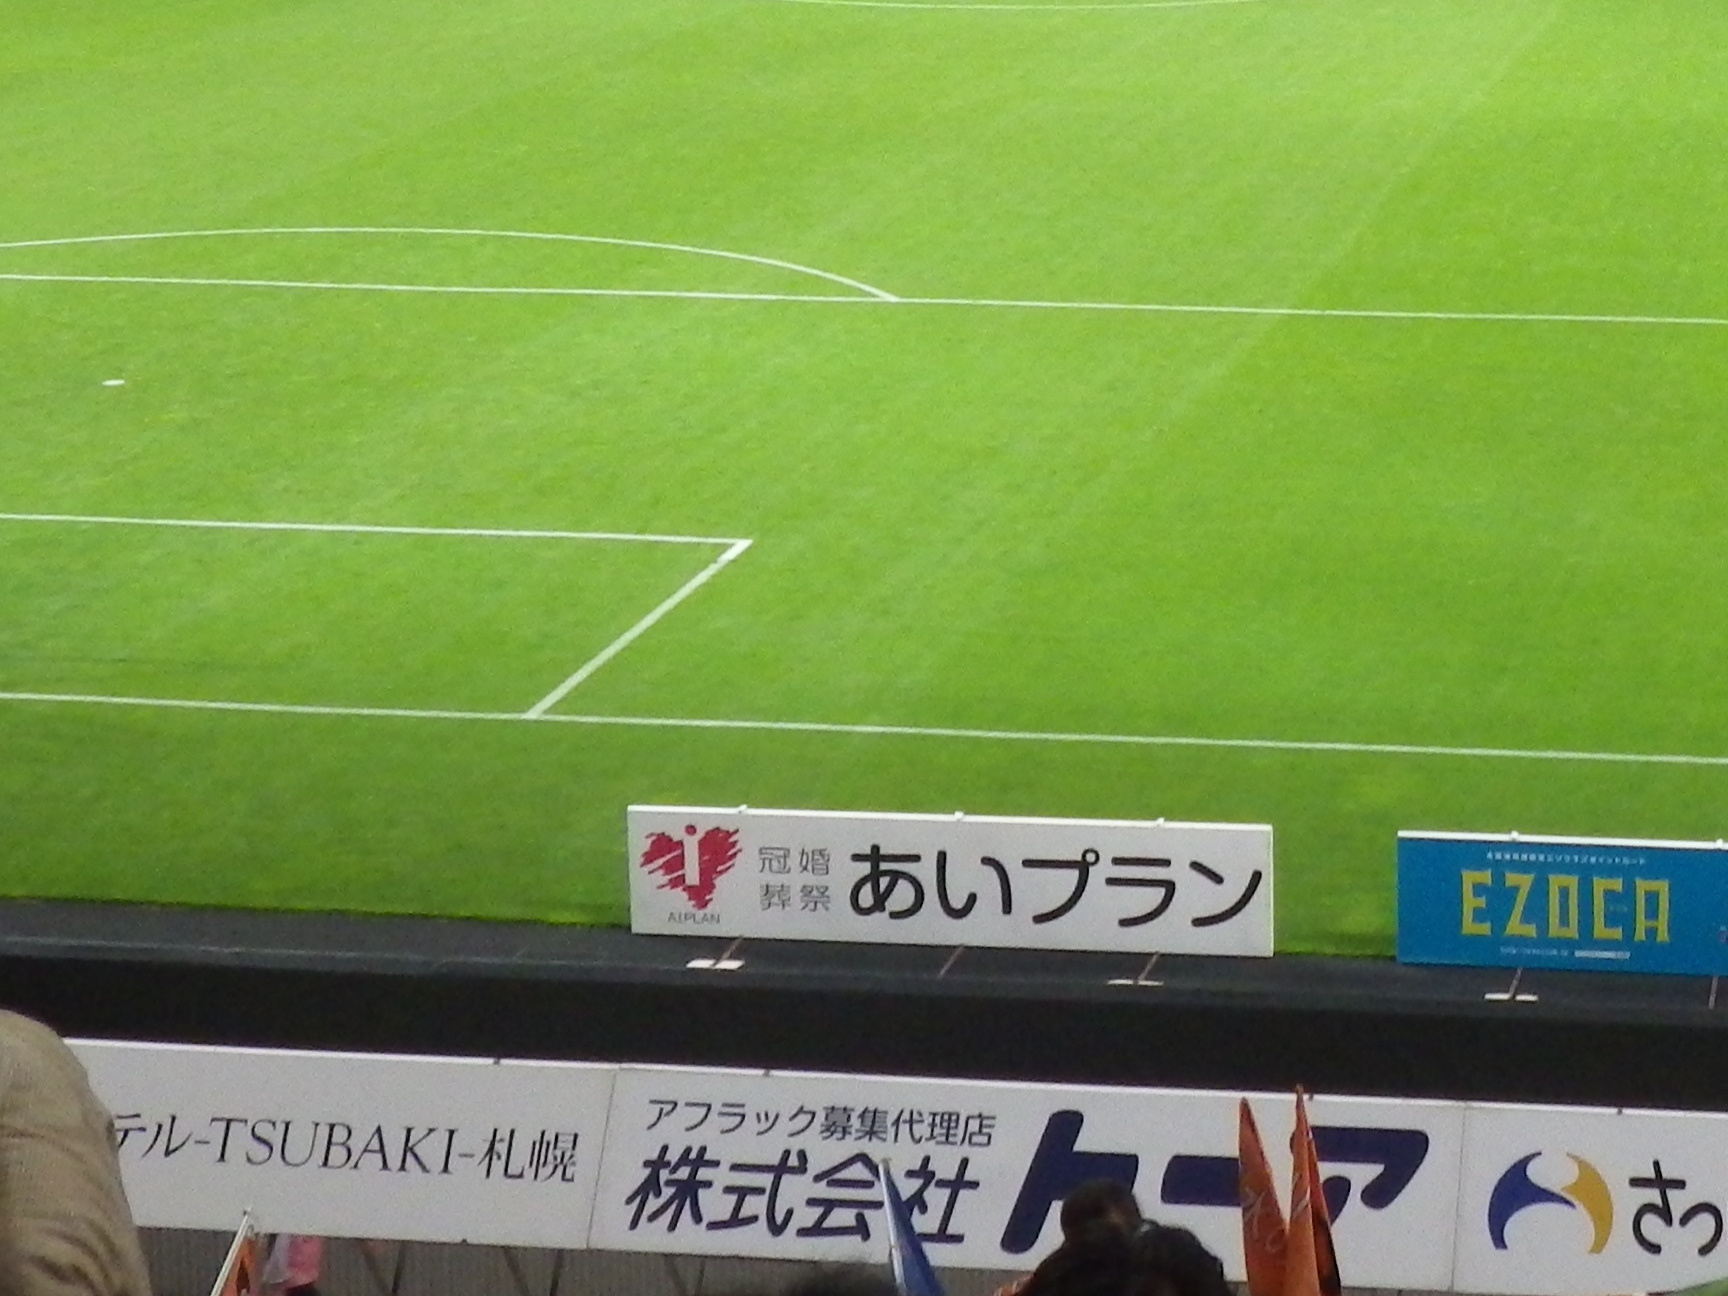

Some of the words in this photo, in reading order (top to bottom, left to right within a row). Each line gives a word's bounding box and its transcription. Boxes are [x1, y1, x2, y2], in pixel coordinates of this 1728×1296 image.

[757, 845, 833, 878] 冠婚
[847, 841, 1264, 930] あいプラン
[666, 911, 722, 927] AIPLAN
[757, 881, 833, 915] 葬祭
[1460, 868, 1671, 943] EZOCA
[646, 1097, 998, 1149] アフラック募集代理店
[622, 1141, 982, 1245] 株式会社
[999, 1107, 1431, 1254] トーア
